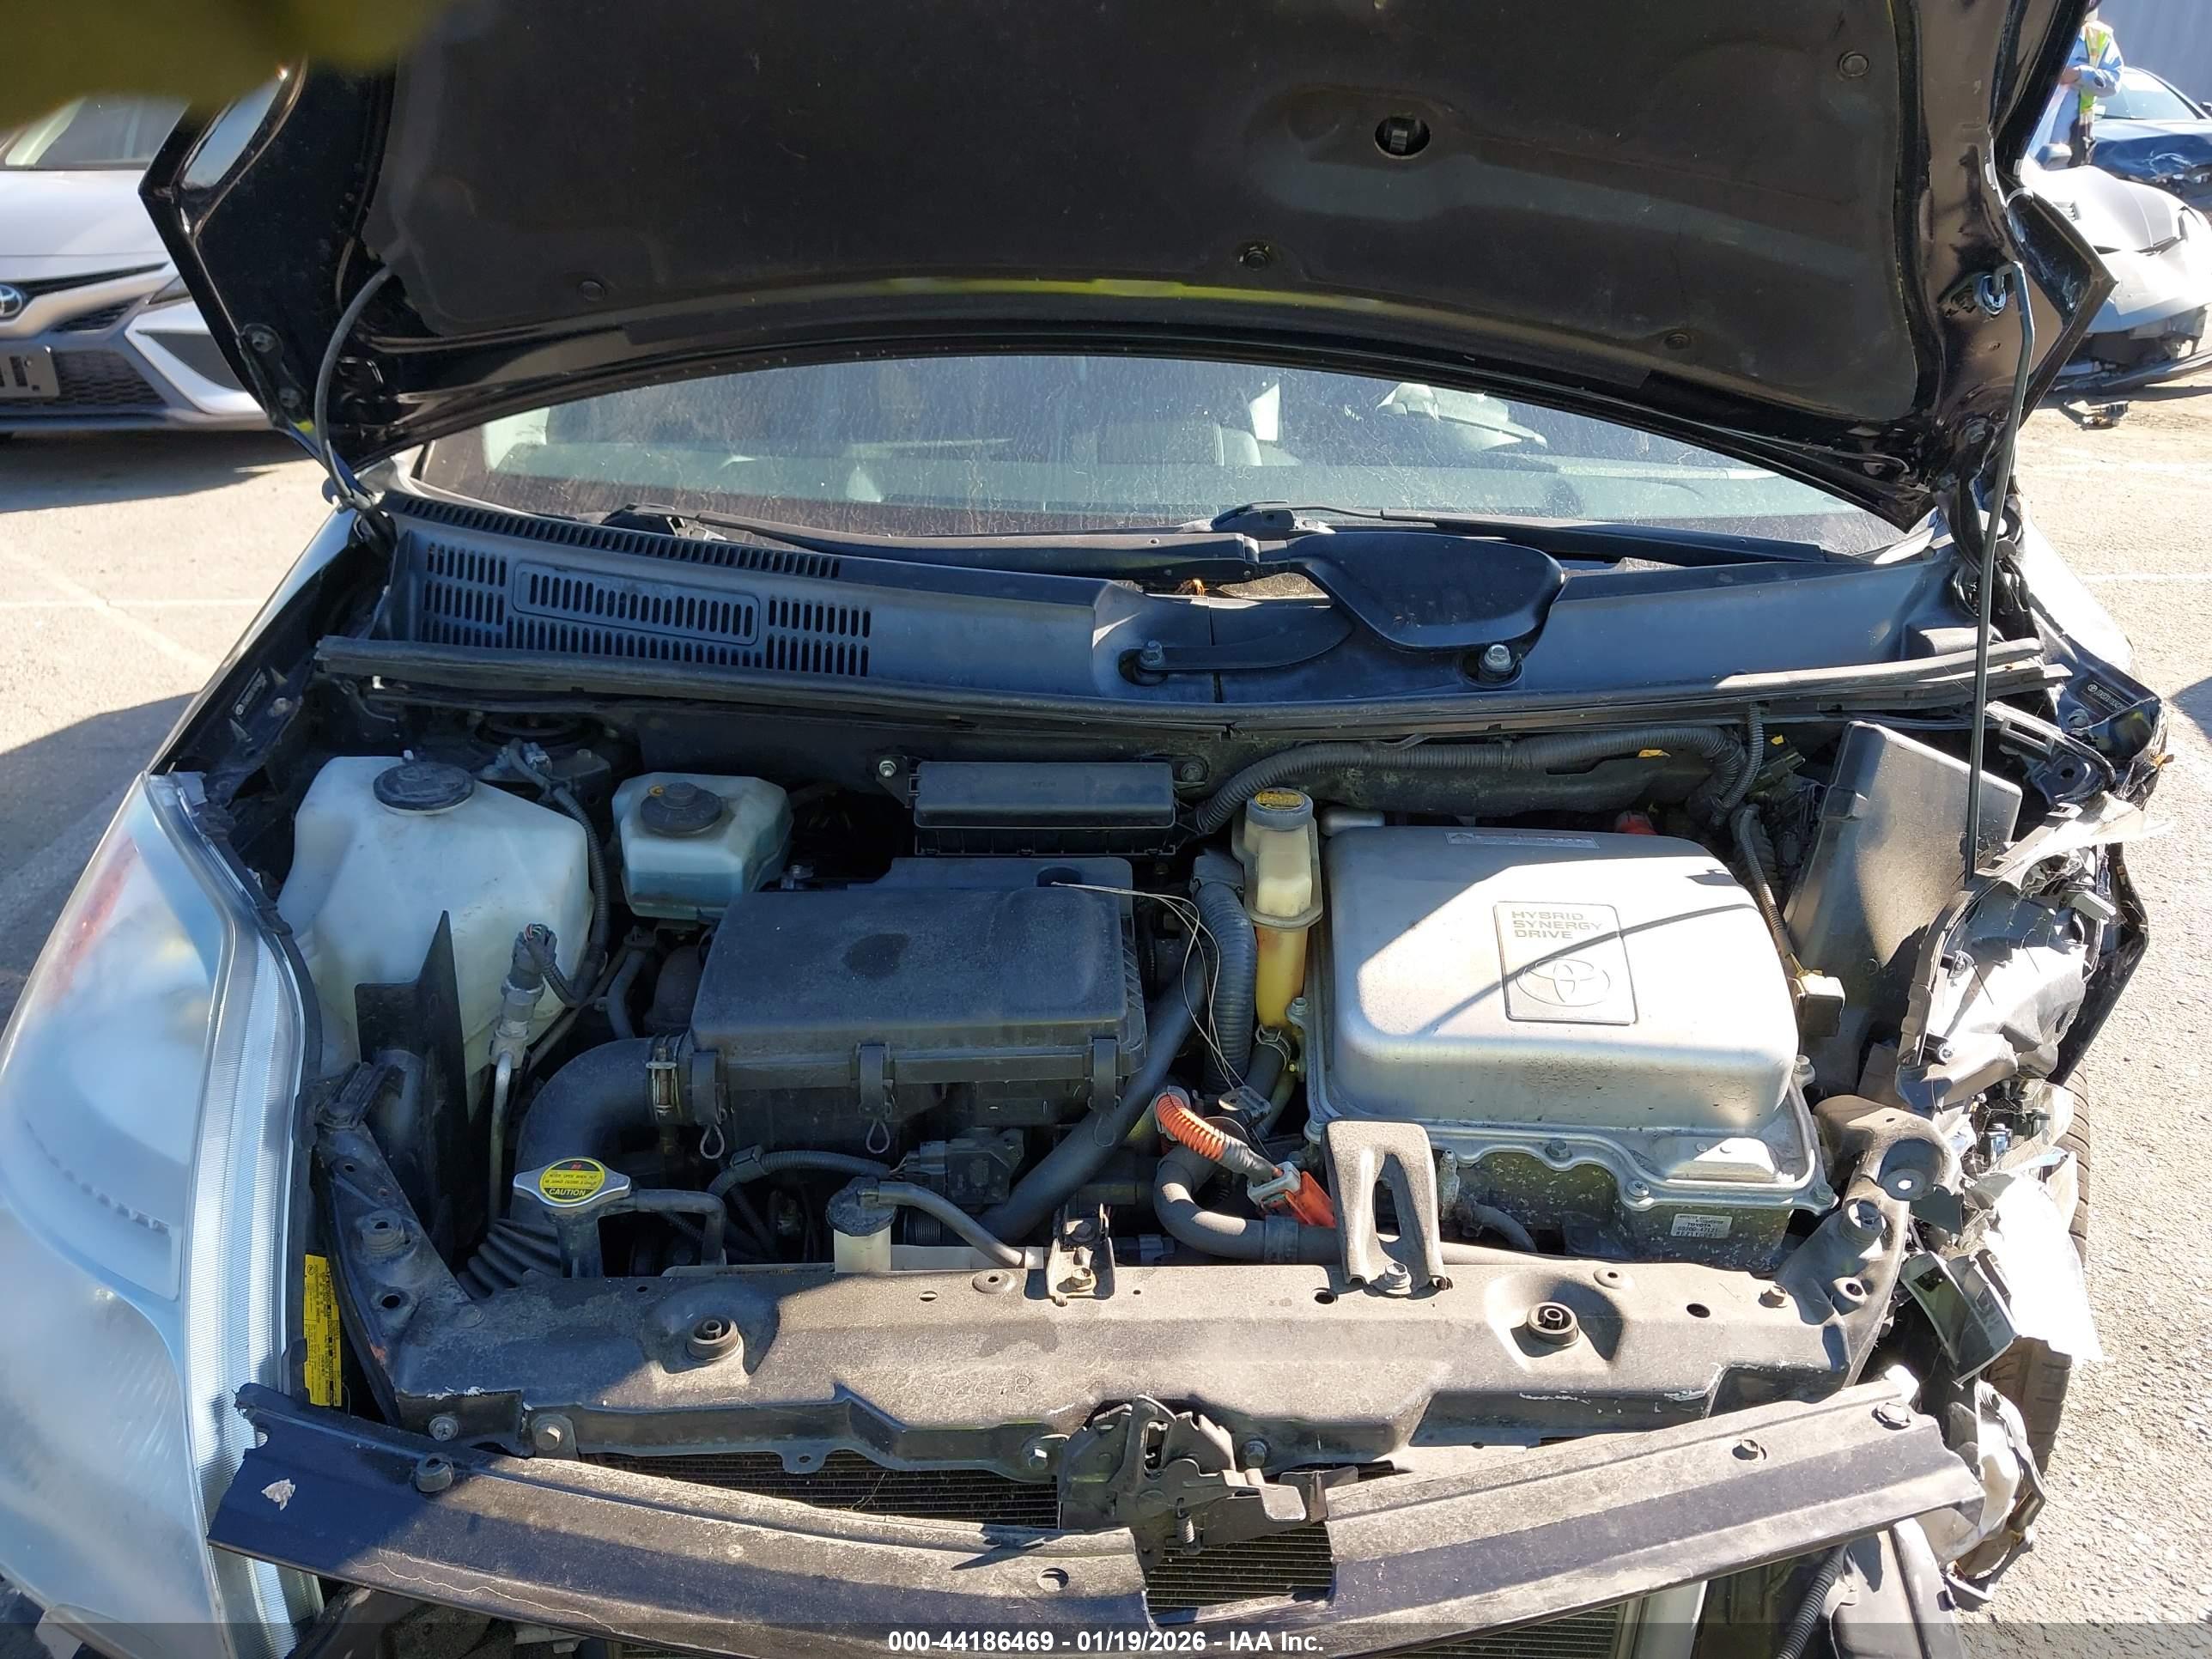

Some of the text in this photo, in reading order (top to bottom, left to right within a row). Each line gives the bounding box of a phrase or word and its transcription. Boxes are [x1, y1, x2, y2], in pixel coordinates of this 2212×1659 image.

[1511, 911, 1583, 920] HYBRID
[1512, 920, 1602, 930] SYNERGY
[1514, 929, 1573, 939] DRIVE
